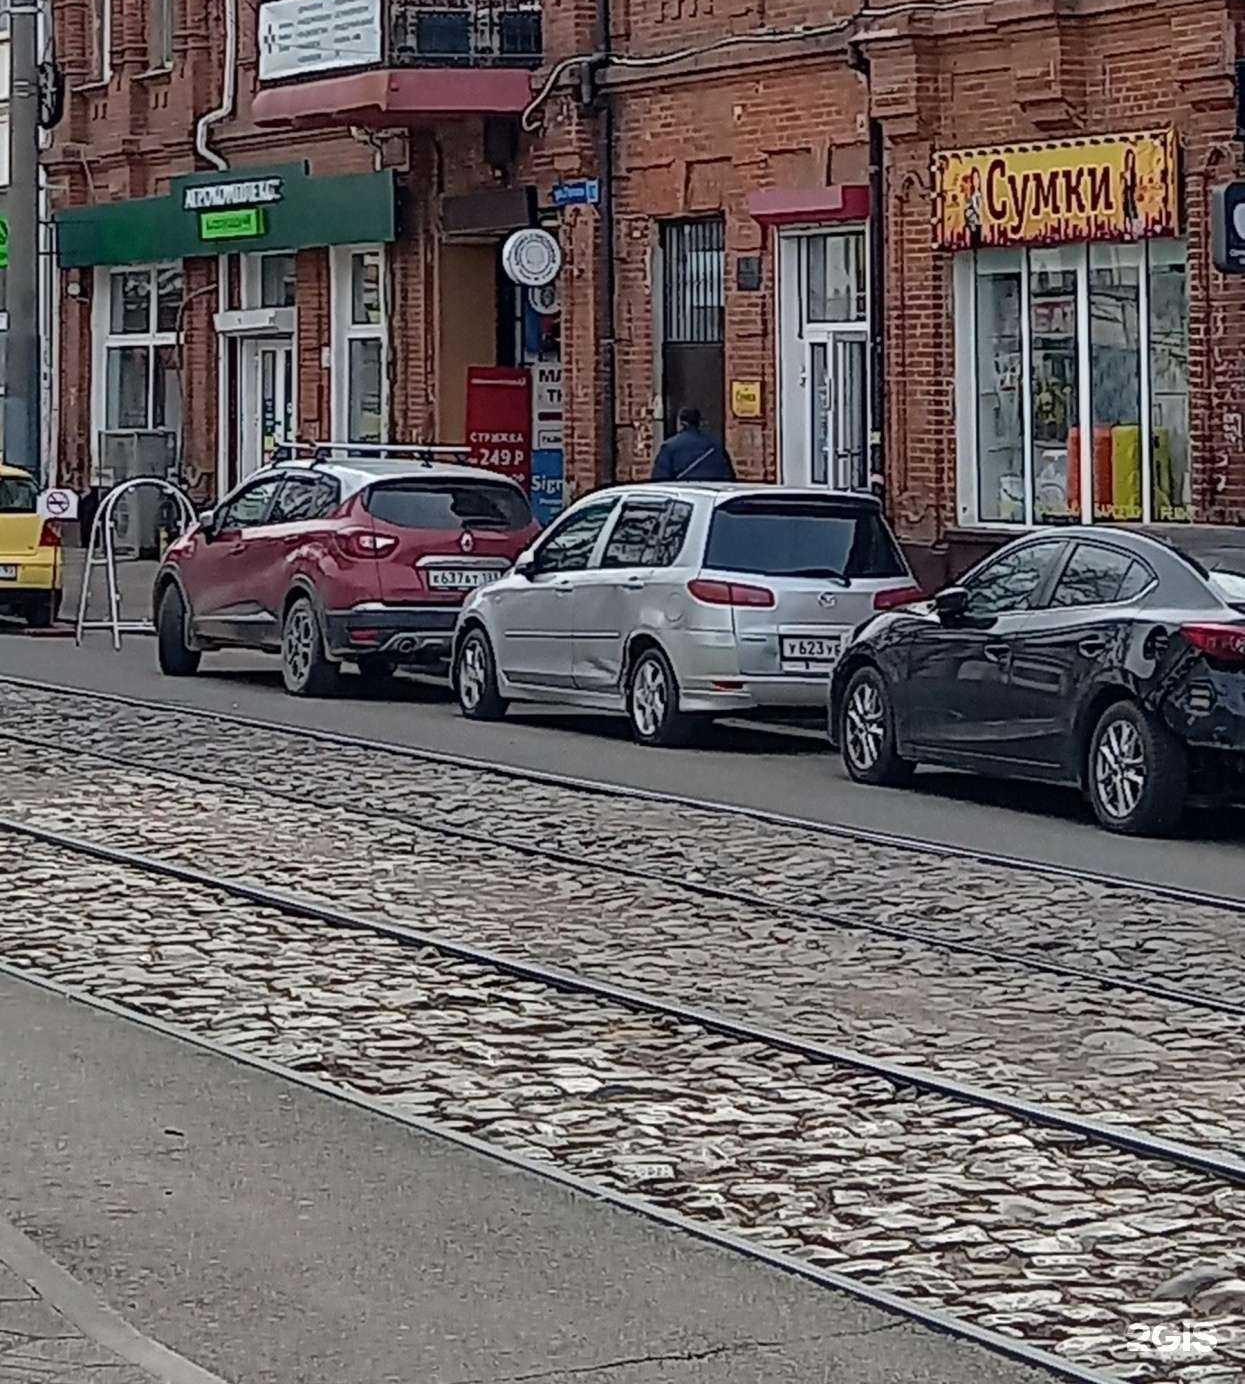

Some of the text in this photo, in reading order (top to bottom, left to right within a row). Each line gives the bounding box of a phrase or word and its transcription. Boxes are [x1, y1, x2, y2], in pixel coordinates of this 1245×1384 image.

[986, 159, 1114, 235] Сумки
[470, 431, 524, 443] СТРИЖКА
[480, 448, 511, 465] 249
